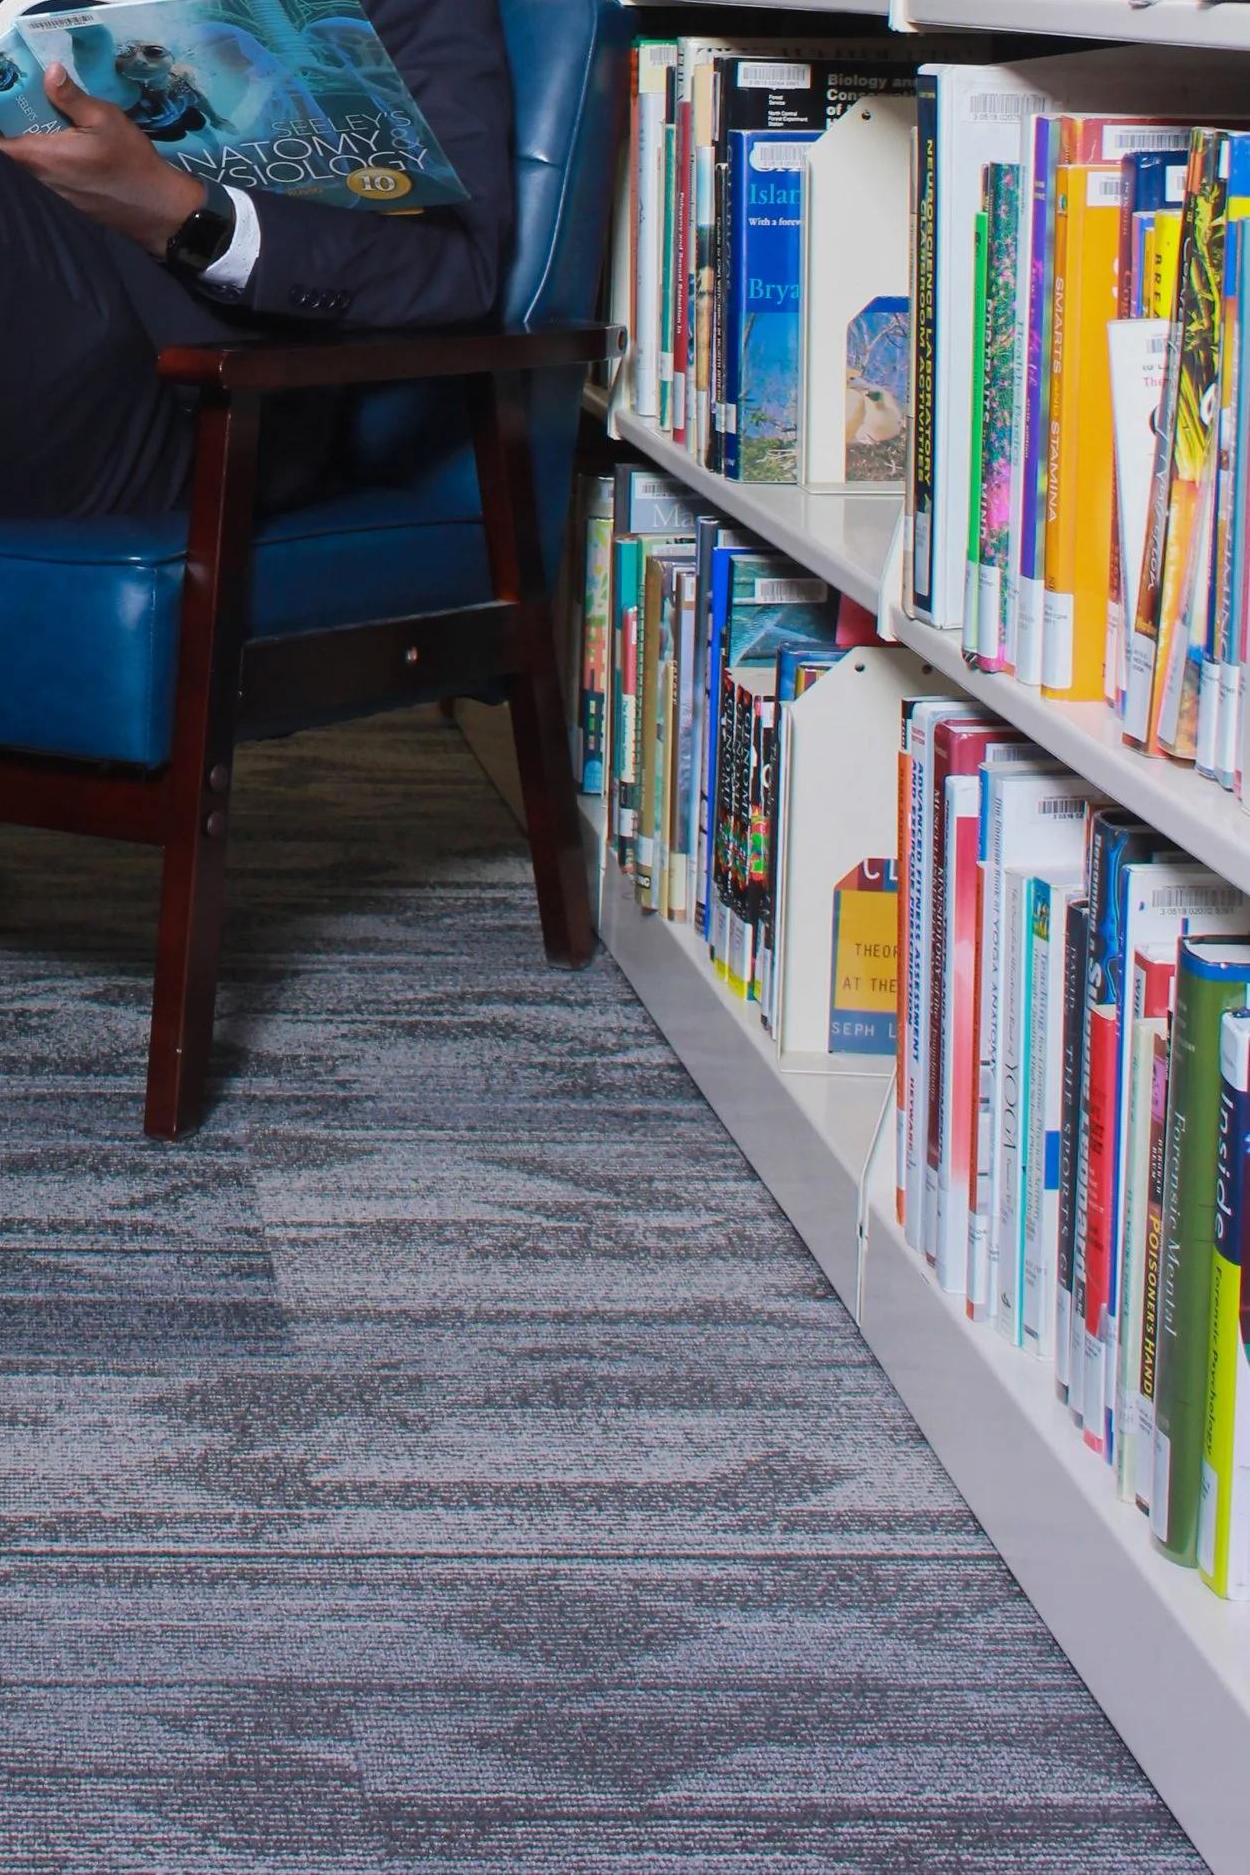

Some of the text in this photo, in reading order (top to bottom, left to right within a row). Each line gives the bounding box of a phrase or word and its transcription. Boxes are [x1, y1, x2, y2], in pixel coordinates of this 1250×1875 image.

[271, 110, 412, 139] SEELEY'S
[827, 73, 887, 89] Biology
[827, 104, 841, 116] of
[177, 123, 426, 172] NATOMY &
[360, 173, 398, 194] 10
[748, 217, 768, 226] With
[917, 198, 927, 484] CLASSROOM ACTIVITIES
[924, 138, 934, 486] NEUROSCIENCE LABORATORY
[979, 298, 992, 540] PORTRAITS MIND
[1013, 405, 1023, 467] Basics
[1048, 275, 1064, 523] SMARTS AND STAMINA
[722, 698, 734, 811] GENOME
[912, 761, 924, 1066] ADVANCED FITNESS ASSESSMENT
[934, 867, 944, 975] KINESIOLOGY
[1089, 831, 1102, 933] Becoming
[870, 977, 897, 993] THE
[908, 894, 917, 1087] PRESCRIPTION
[933, 998, 941, 1019] the
[990, 919, 1000, 1078] YOGA ANATOMY
[1068, 946, 1078, 1012] DAVID
[1003, 1062, 1018, 1151] YOGA
[1029, 1052, 1038, 1085] High
[1034, 951, 1048, 1165] Teaching Lifetime Physical
[1061, 1044, 1074, 1237] THE SPORTS
[1150, 1146, 1158, 1179] BLUM
[1156, 1138, 1164, 1194] DEBORAH
[1213, 1091, 1234, 1240] Inside
[1145, 1214, 1161, 1335] POISONER'S
[1162, 1110, 1186, 1338] Forensic Mental
[1203, 1263, 1223, 1457] Forensic Psychology
